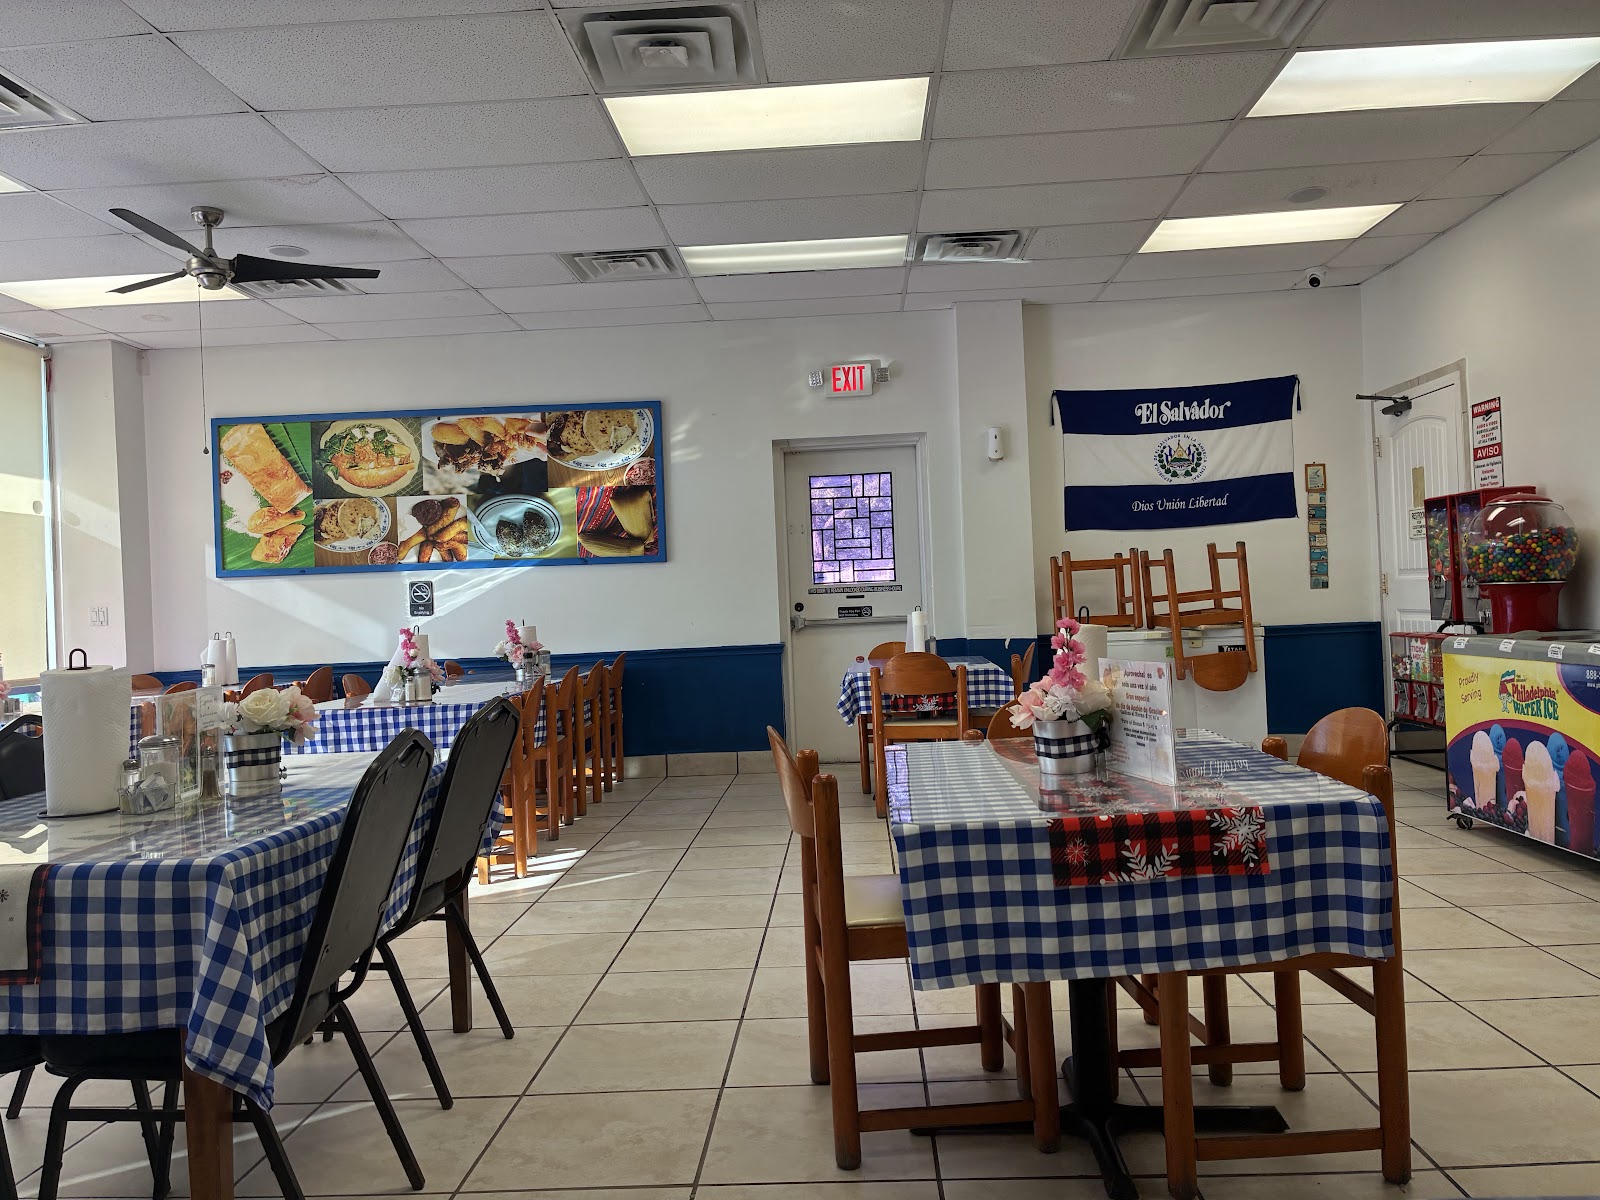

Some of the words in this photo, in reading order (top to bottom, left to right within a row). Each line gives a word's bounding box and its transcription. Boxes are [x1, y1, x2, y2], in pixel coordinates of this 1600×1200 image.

[831, 366, 865, 392] EXIT
[1135, 403, 1158, 425] El
[1472, 400, 1500, 415] WARNING
[1477, 446, 1499, 459] AVISO
[1132, 500, 1154, 512] Dios
[1156, 498, 1186, 511] Unión
[1188, 493, 1229, 509] Libertad
[1459, 672, 1478, 688] Proudly
[1586, 669, 1600, 680] 888-
[1461, 689, 1481, 704] Serving
[1511, 683, 1556, 702] Philadelphia
[1512, 699, 1543, 718] WATER
[1543, 698, 1559, 720] ICE
